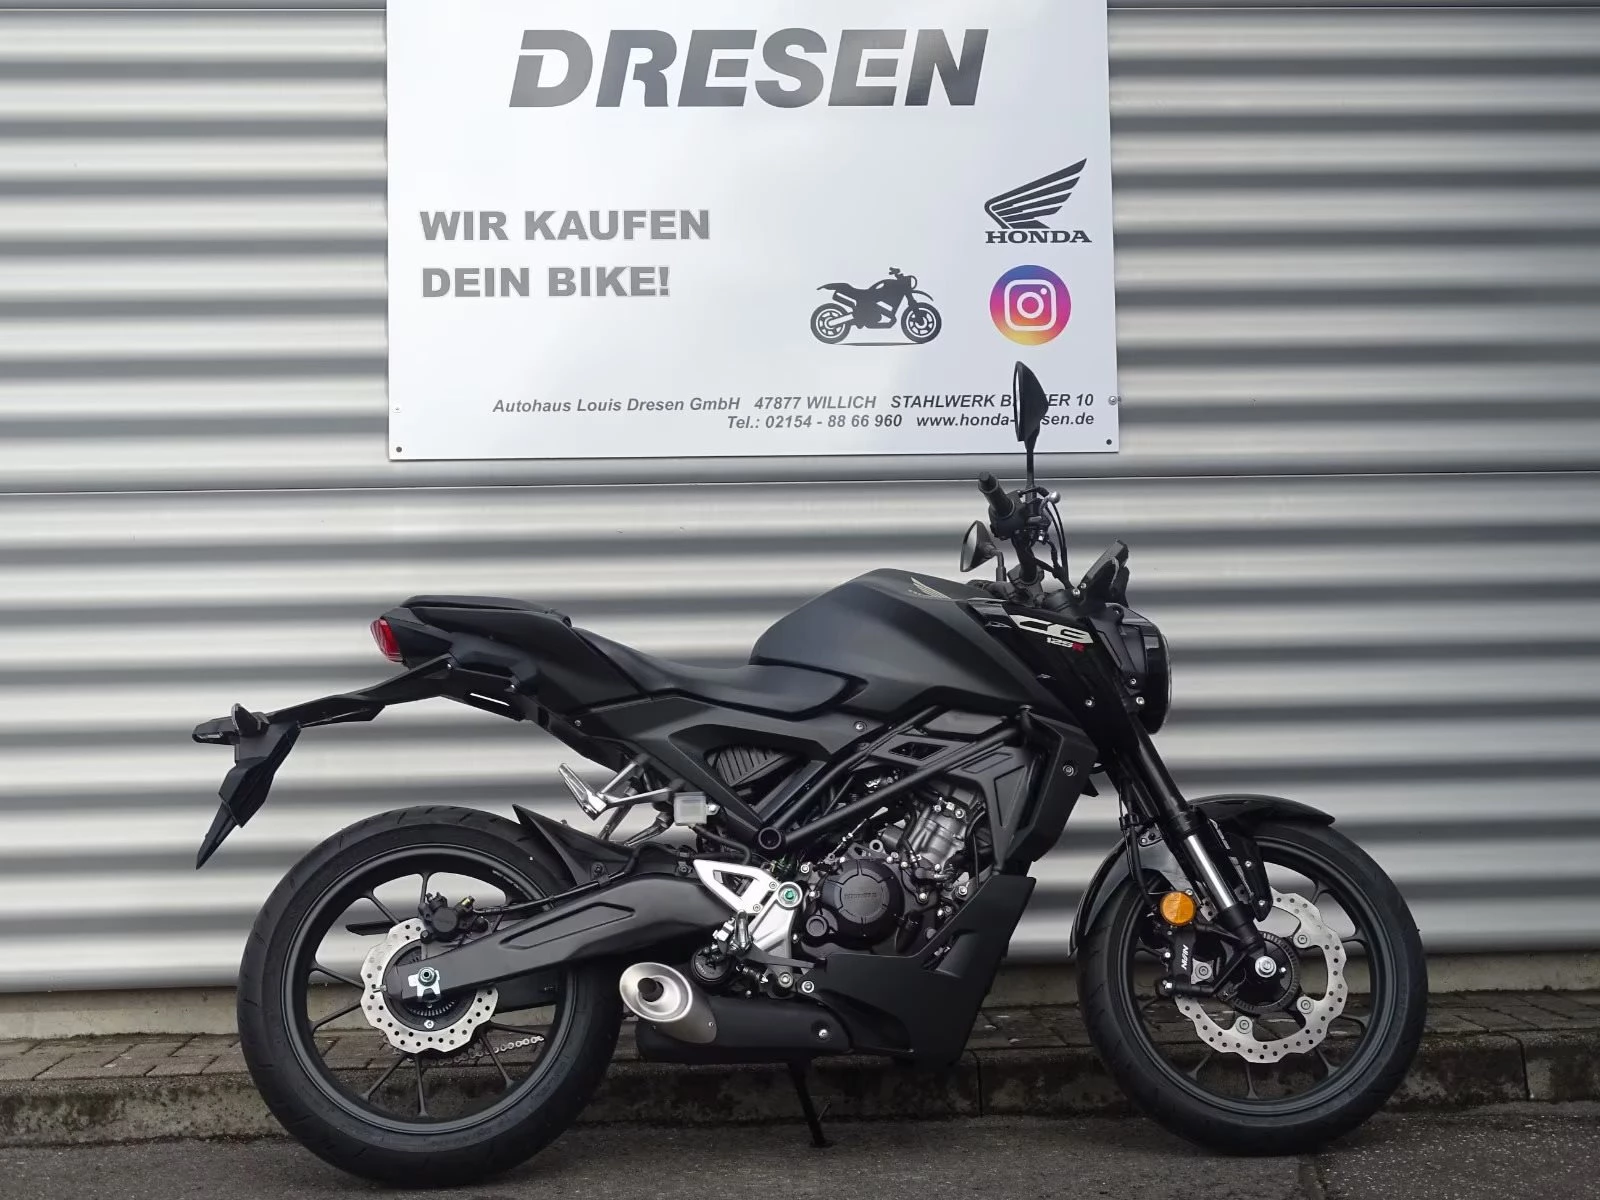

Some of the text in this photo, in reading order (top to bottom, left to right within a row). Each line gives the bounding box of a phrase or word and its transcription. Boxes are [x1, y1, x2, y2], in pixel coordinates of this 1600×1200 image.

[509, 28, 989, 108] DRESEN
[419, 210, 710, 241] WIR KAUFEN
[985, 230, 1092, 244] HONDA
[422, 266, 669, 298] DEIN BIKE!
[492, 399, 572, 412] Autohaus
[577, 398, 622, 412] Louis
[627, 398, 685, 411] Dresen
[689, 397, 741, 411] GmbH
[754, 396, 802, 410] 47877
[806, 396, 877, 410] WILLICH
[891, 394, 996, 408] STAHLWERK
[1076, 393, 1094, 407] 10
[728, 415, 760, 429] Tel.:
[765, 415, 812, 429] 02154
[827, 415, 846, 428] 88
[851, 415, 870, 428] 66
[874, 414, 903, 428] 960
[916, 411, 1095, 427] www.honda-sen.de
